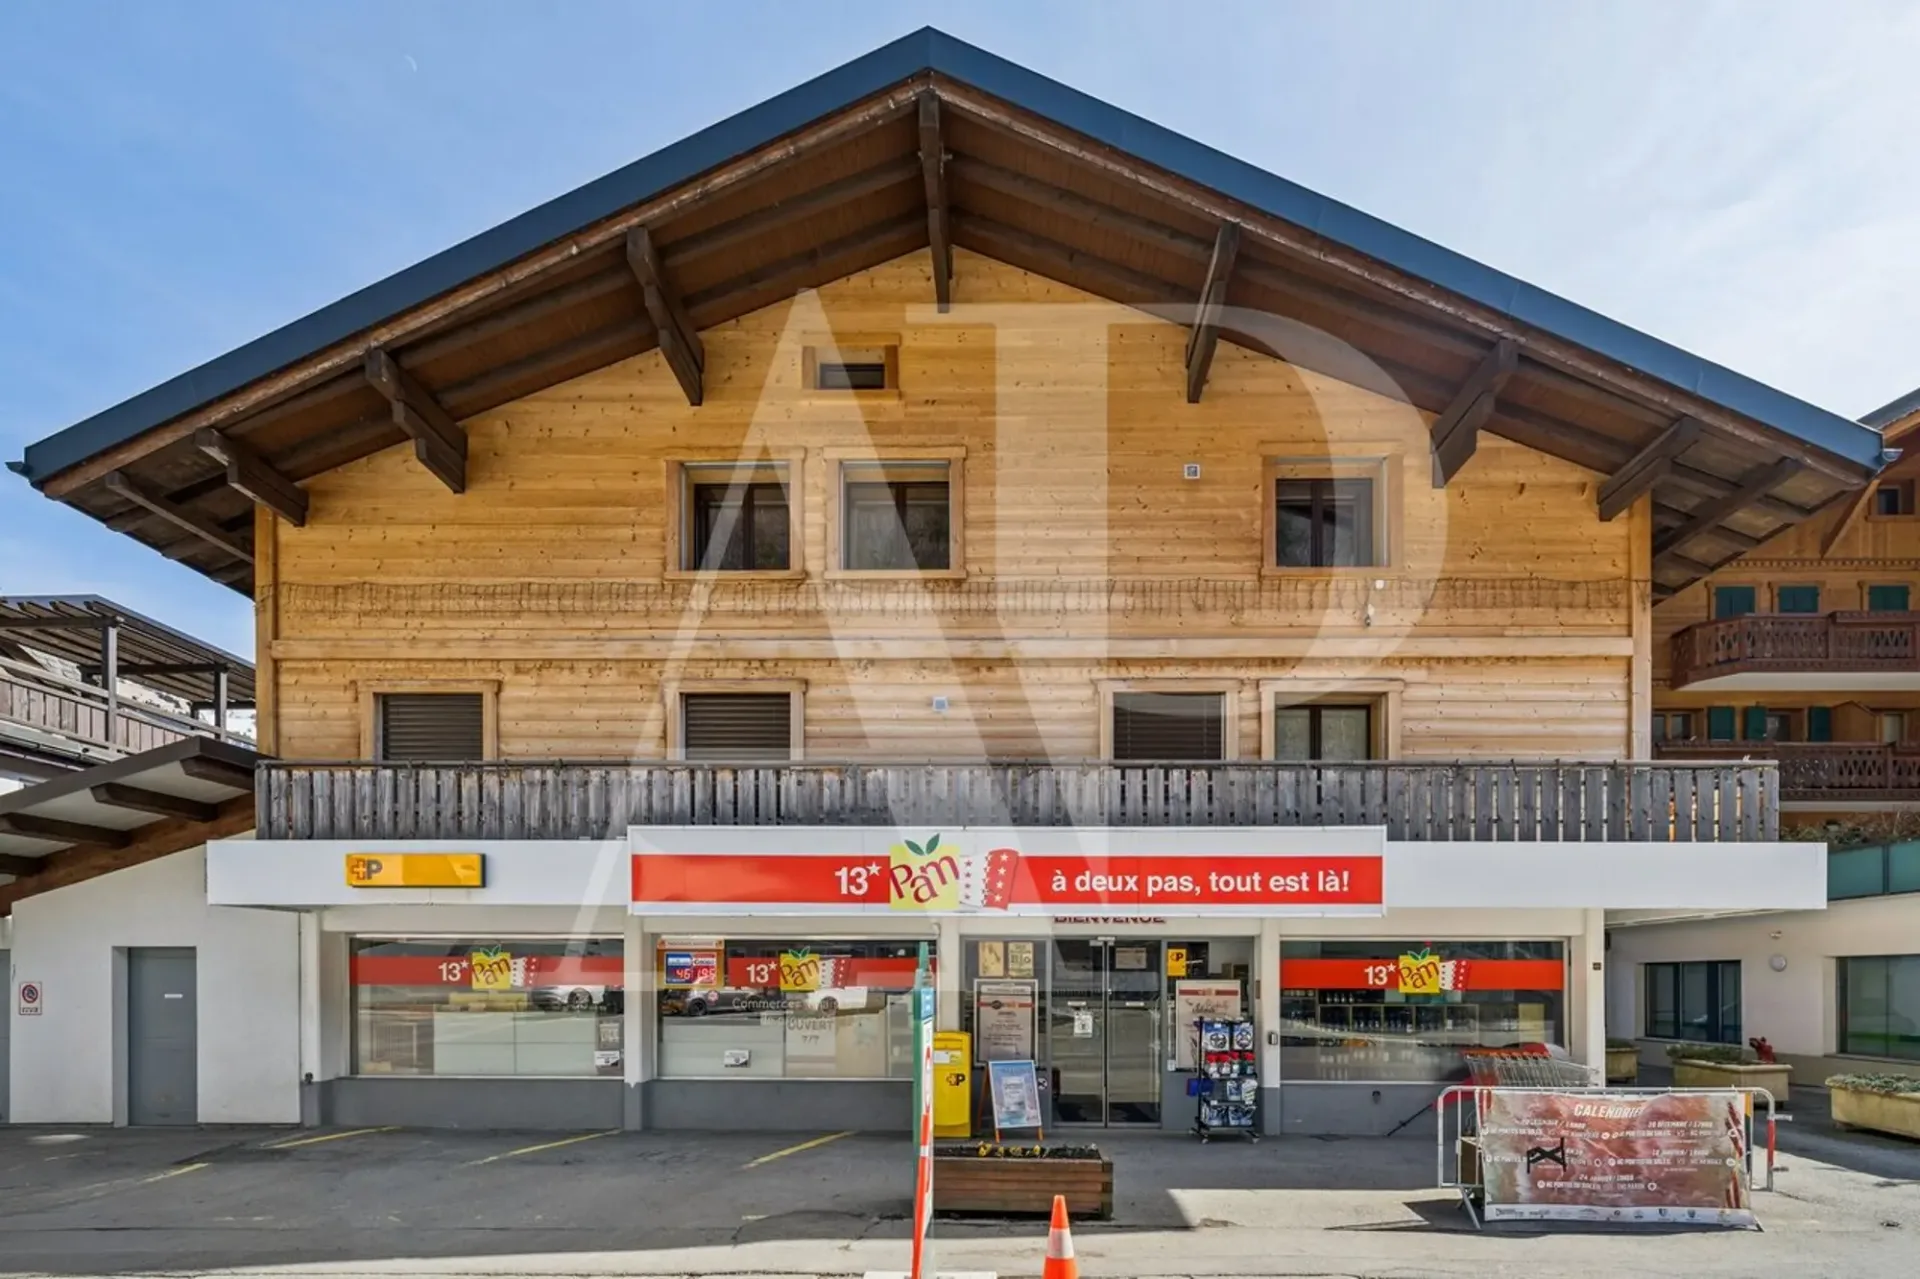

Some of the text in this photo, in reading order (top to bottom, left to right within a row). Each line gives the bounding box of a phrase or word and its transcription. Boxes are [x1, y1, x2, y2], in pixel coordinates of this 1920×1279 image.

[366, 858, 383, 880] P
[889, 854, 960, 903] Pam
[1051, 869, 1350, 898] à deux pas, tout est là!
[471, 957, 511, 986] Pam
[779, 958, 819, 988] Pam
[1398, 960, 1440, 989] Pam
[786, 1019, 835, 1031] OUVERT
